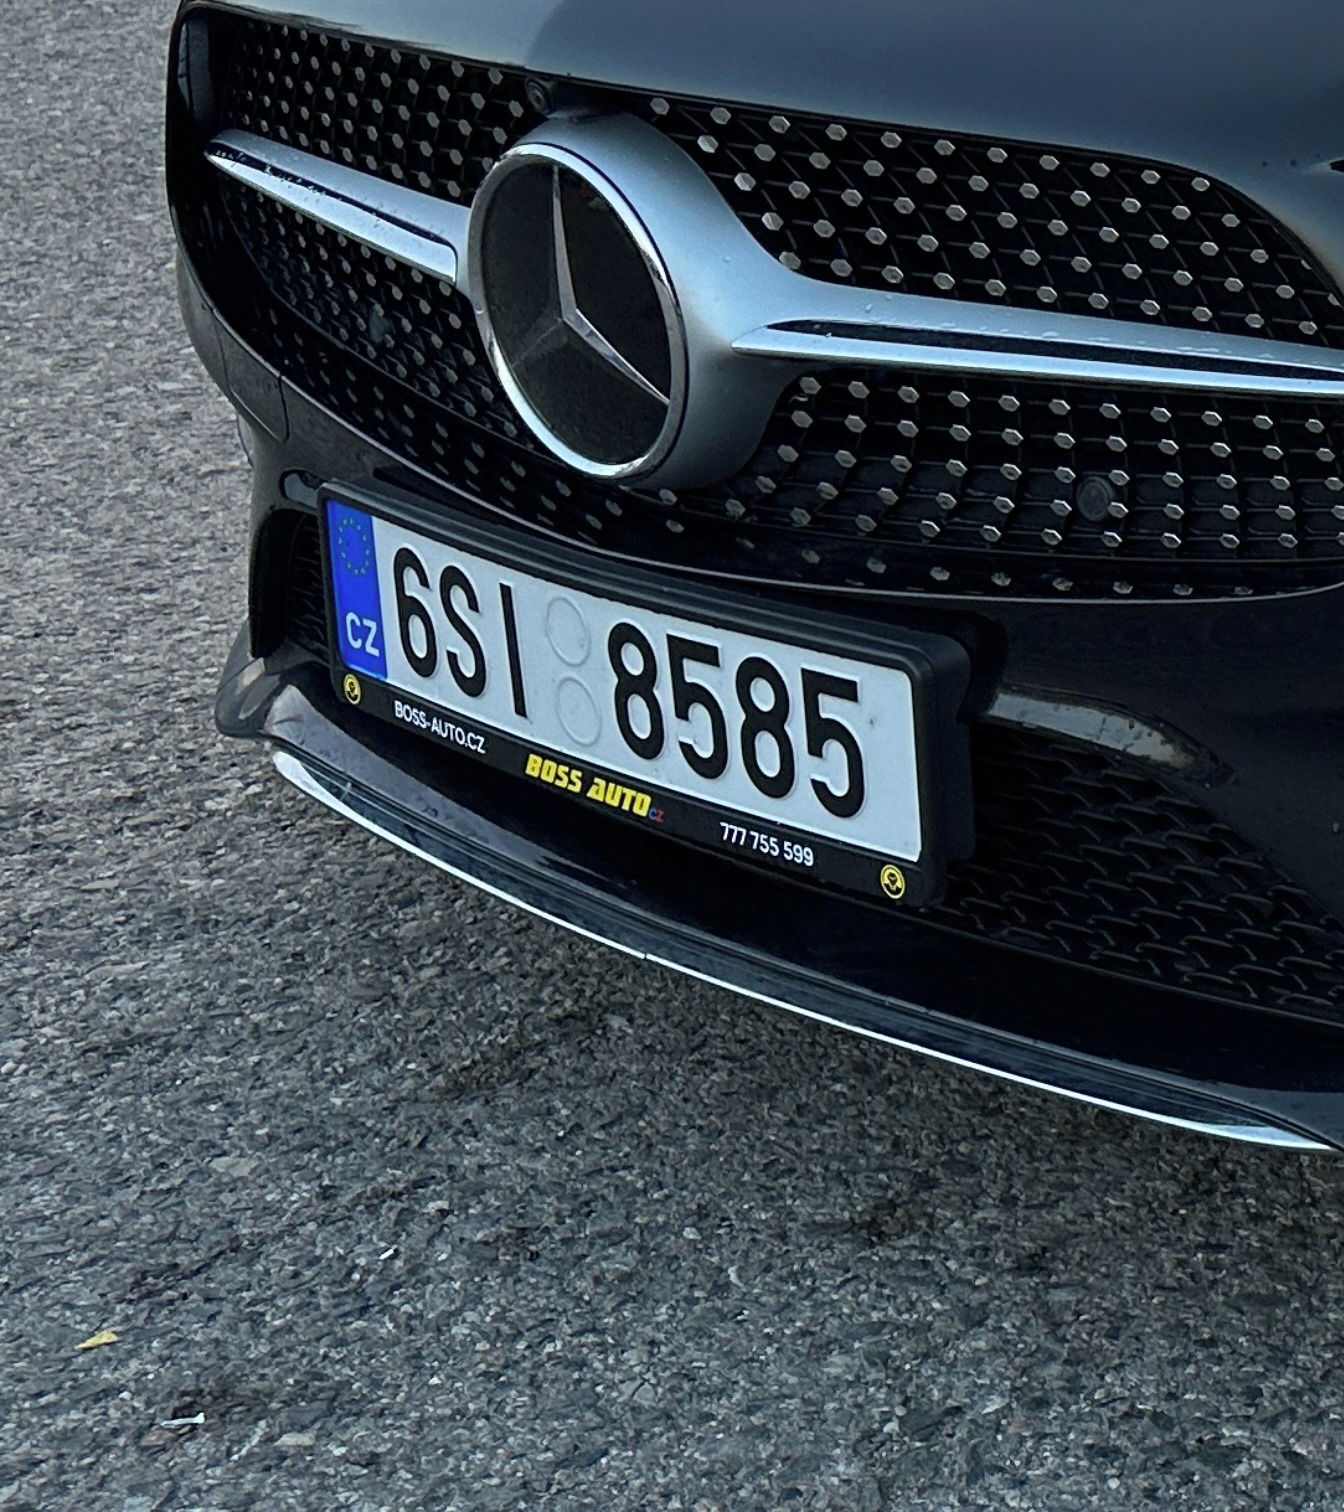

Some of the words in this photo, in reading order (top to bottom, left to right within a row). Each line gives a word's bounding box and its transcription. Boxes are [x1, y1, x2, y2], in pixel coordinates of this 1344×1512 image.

[345, 611, 380, 657] CZ
[392, 547, 528, 719] 6SI
[607, 621, 866, 819] 8585
[394, 700, 487, 755] BOSS-AUTO.CZ
[525, 753, 583, 793] BOSS
[586, 777, 651, 817] AUTO
[719, 821, 747, 846] 777
[749, 830, 779, 856] 755
[783, 840, 814, 867] 599
